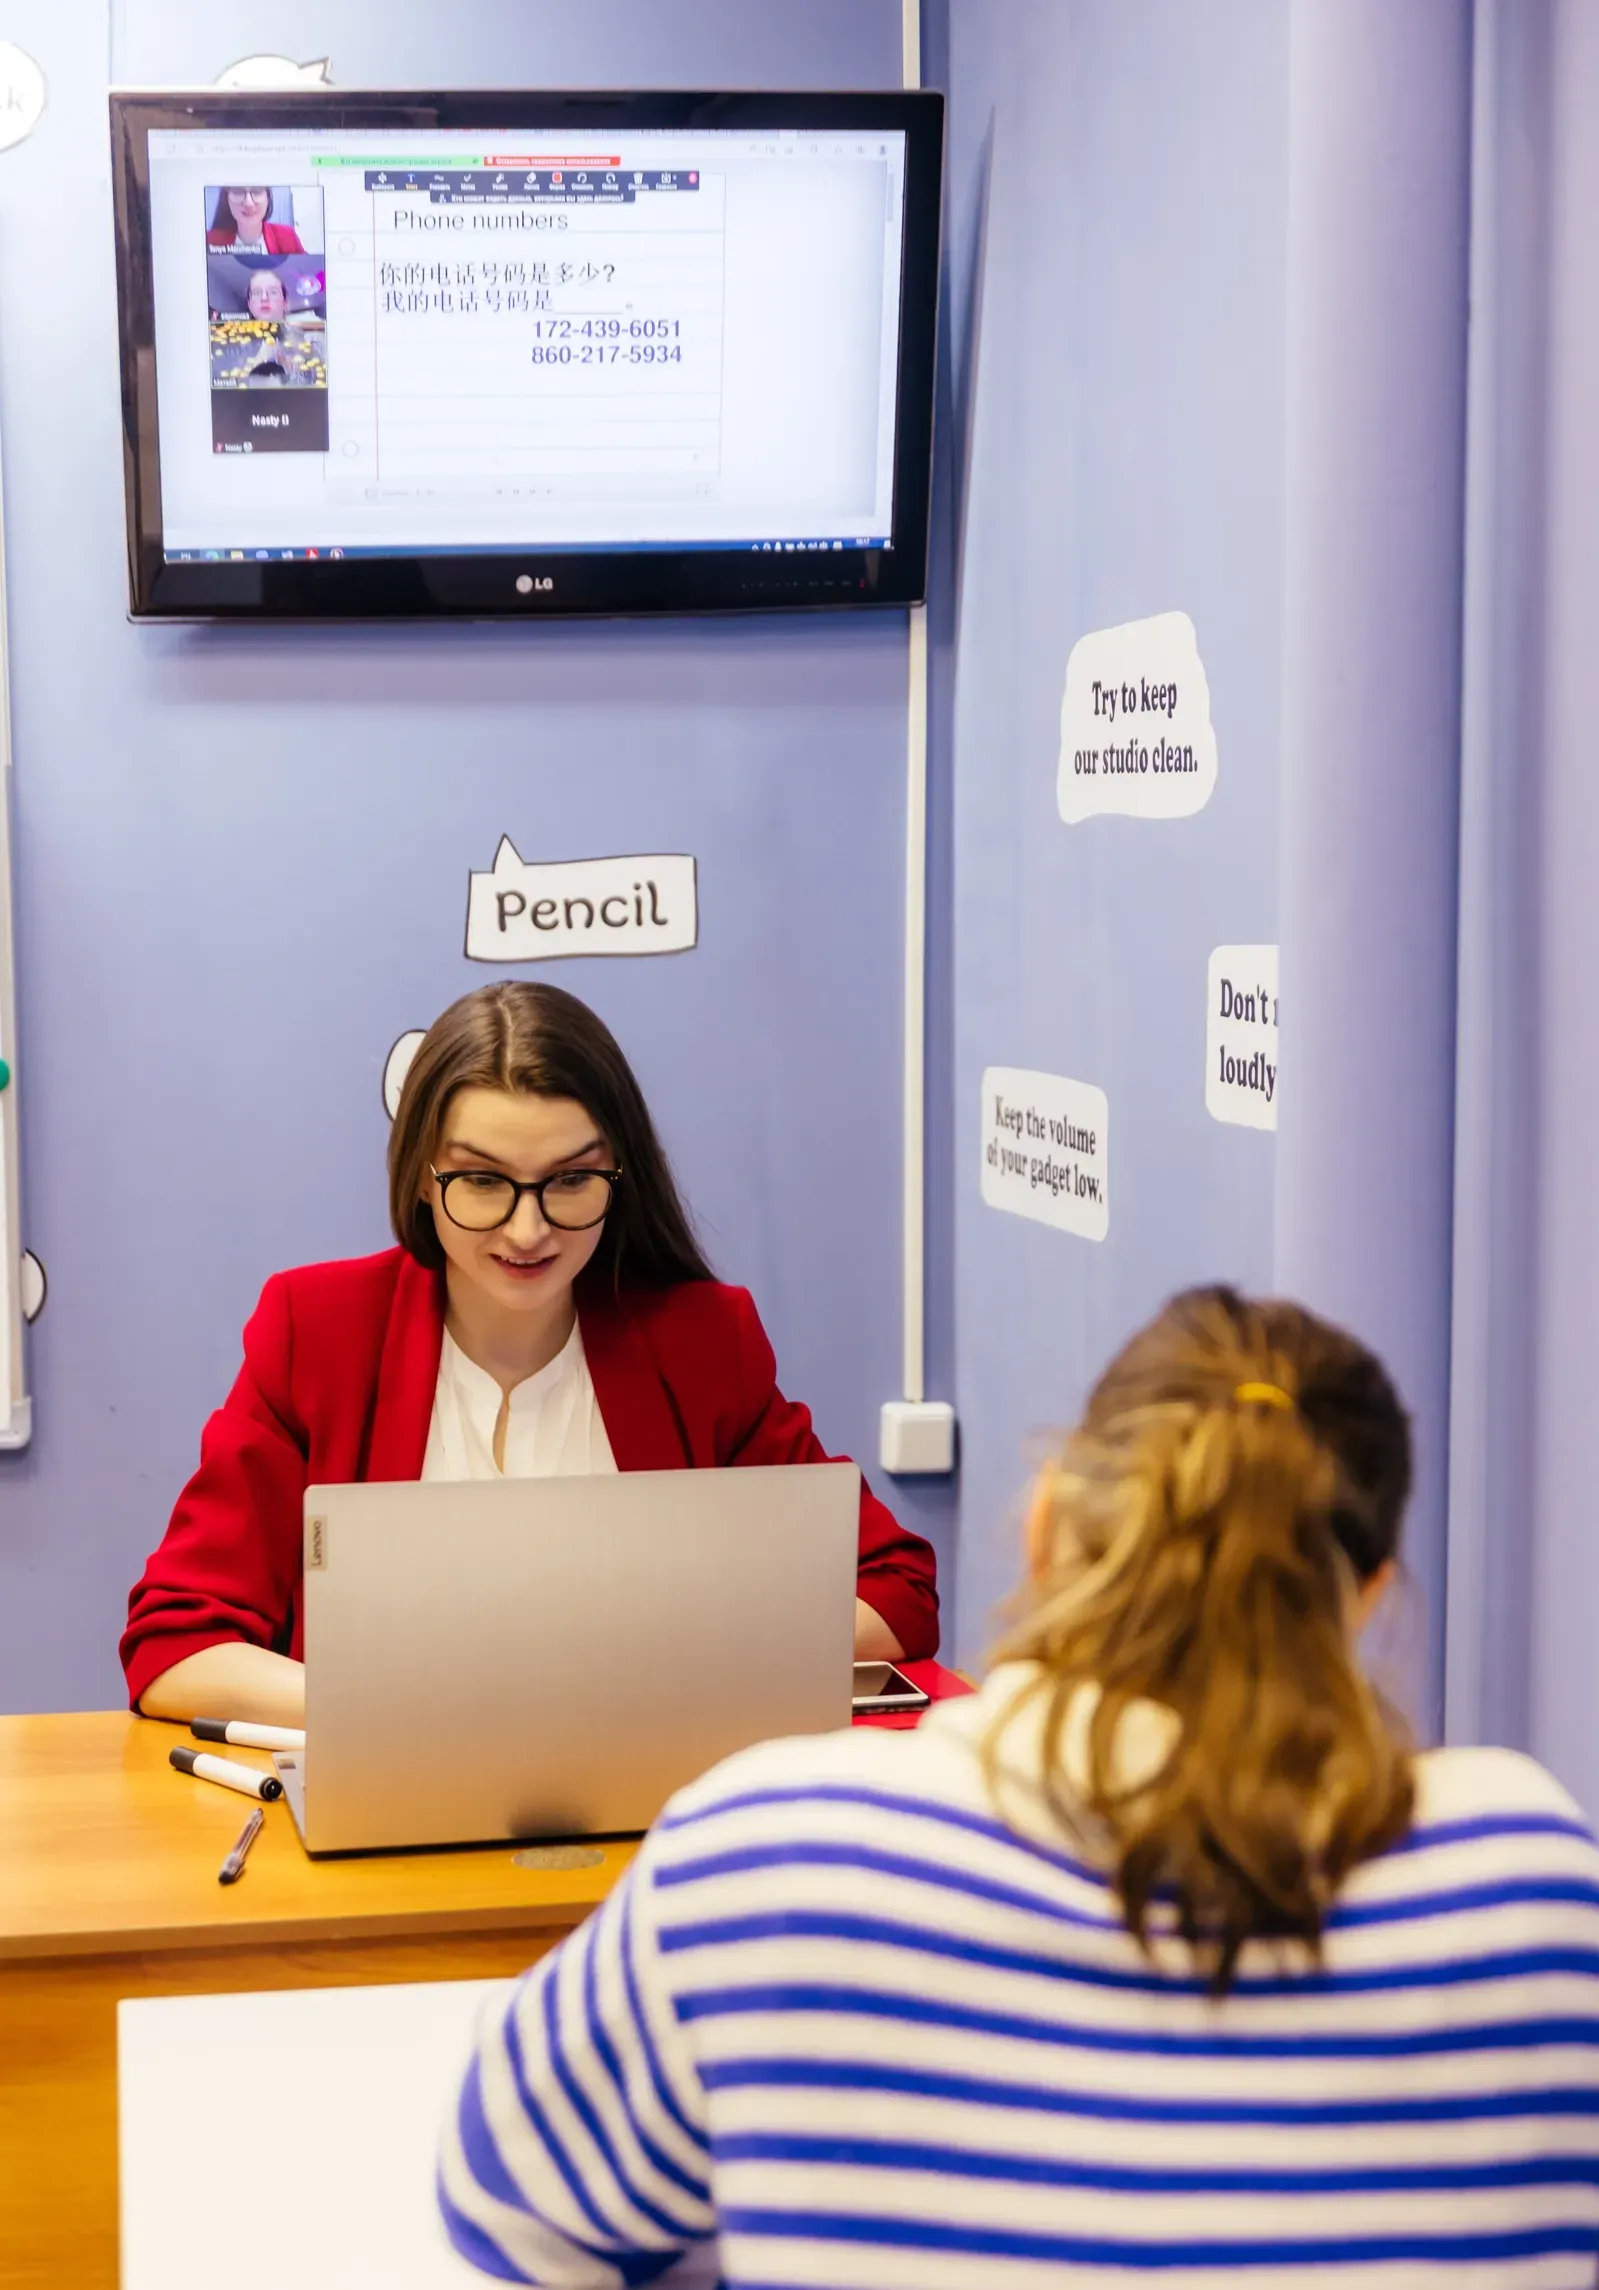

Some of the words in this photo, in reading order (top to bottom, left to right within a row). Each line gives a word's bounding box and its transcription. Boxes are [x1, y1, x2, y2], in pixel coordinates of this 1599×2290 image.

[394, 210, 464, 231] Phone
[473, 210, 568, 231] numbers
[532, 320, 681, 339] 172-439-6051
[531, 345, 683, 364] 860-217-5934
[535, 577, 554, 591] LG
[1092, 680, 1118, 722] Try
[1121, 681, 1137, 713] to
[1140, 675, 1178, 719] keep
[1074, 749, 1099, 775] our
[1102, 737, 1149, 775] studio
[1152, 736, 1199, 774] clean.
[495, 879, 669, 933] Pencil
[1220, 977, 1269, 1026] Don't
[995, 1094, 1024, 1140] Keep
[1026, 1105, 1047, 1141] the
[1049, 1114, 1097, 1156] volume
[987, 1136, 999, 1168] of
[1001, 1146, 1028, 1177] your
[1031, 1154, 1072, 1197] gadget
[1074, 1163, 1103, 1205] low.
